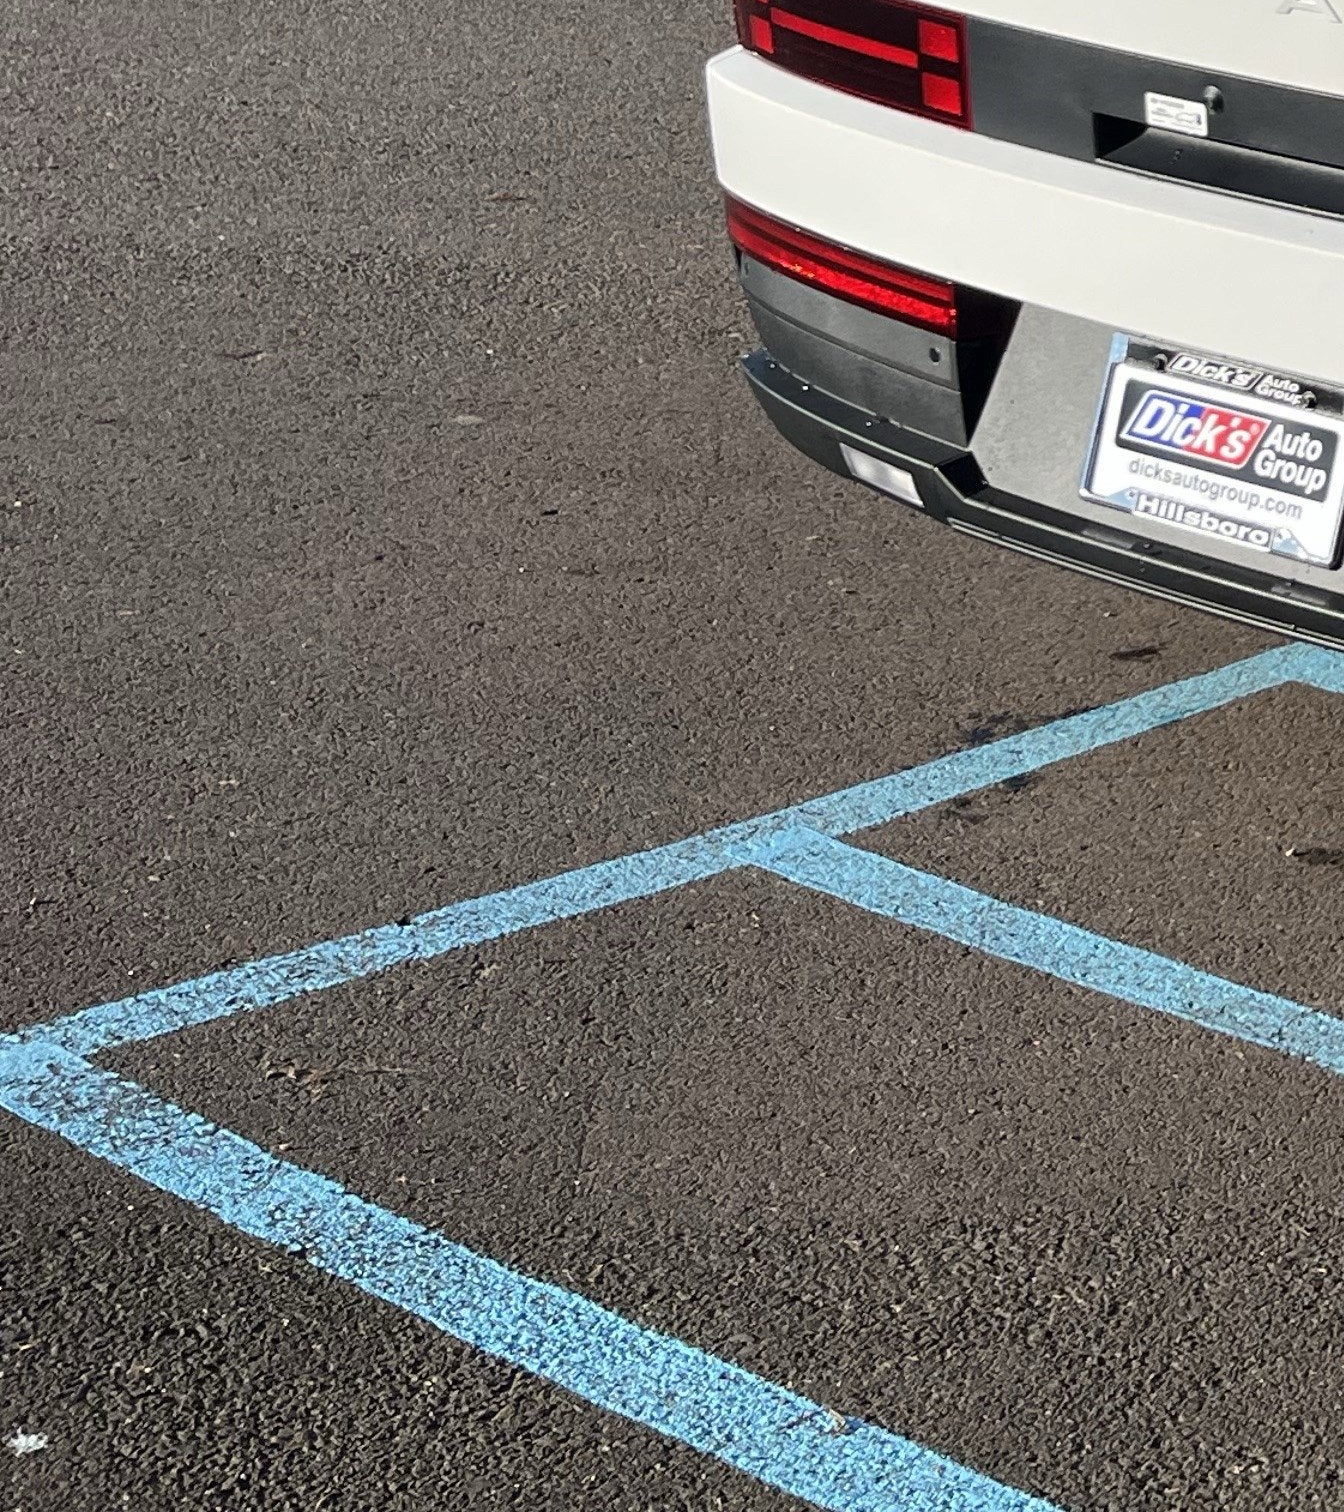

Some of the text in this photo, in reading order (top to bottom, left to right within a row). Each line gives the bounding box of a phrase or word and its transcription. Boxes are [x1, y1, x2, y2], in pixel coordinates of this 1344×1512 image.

[1171, 355, 1254, 388] Dick's
[1258, 374, 1301, 393] Auto
[1254, 383, 1304, 407] Group
[1131, 397, 1251, 460] Dick's
[1262, 423, 1323, 462] Auto
[1128, 457, 1304, 520] dicksautogroup.com
[1253, 448, 1327, 495] Group
[1136, 491, 1270, 546] Hillsboro
